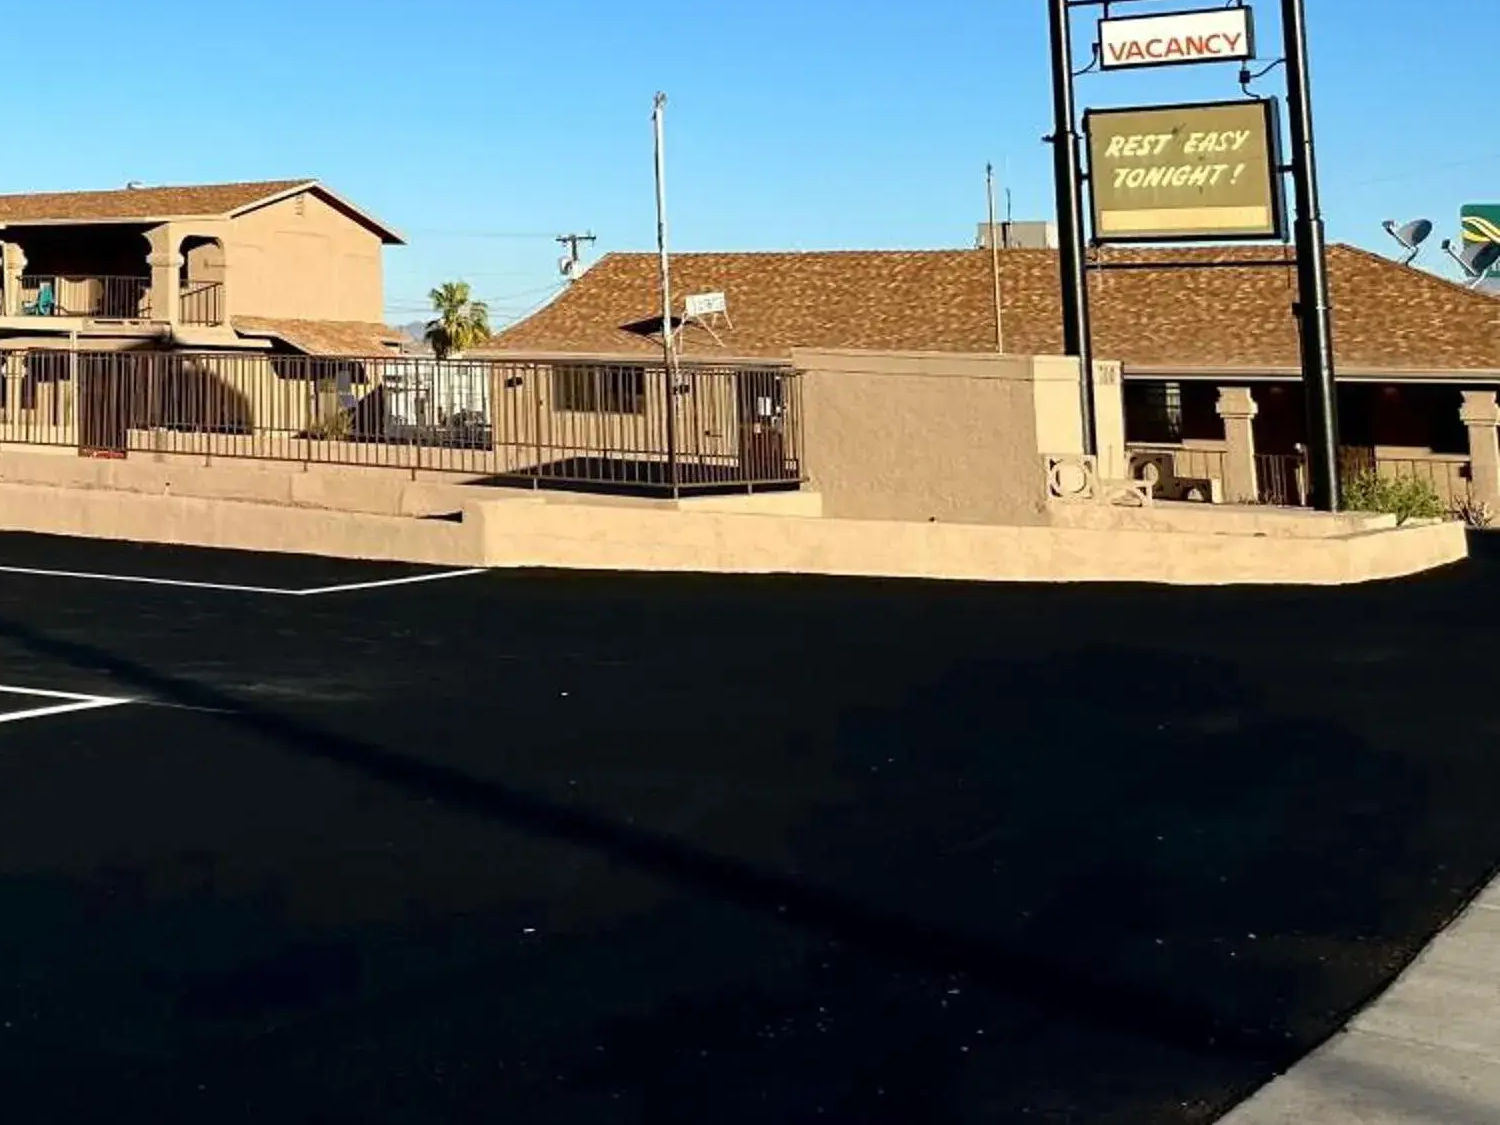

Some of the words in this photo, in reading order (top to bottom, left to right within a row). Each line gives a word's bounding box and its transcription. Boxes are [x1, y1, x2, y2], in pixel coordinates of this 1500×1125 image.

[1108, 32, 1242, 61] VACANCY
[1104, 133, 1173, 158] REST
[1184, 129, 1250, 154] EASY
